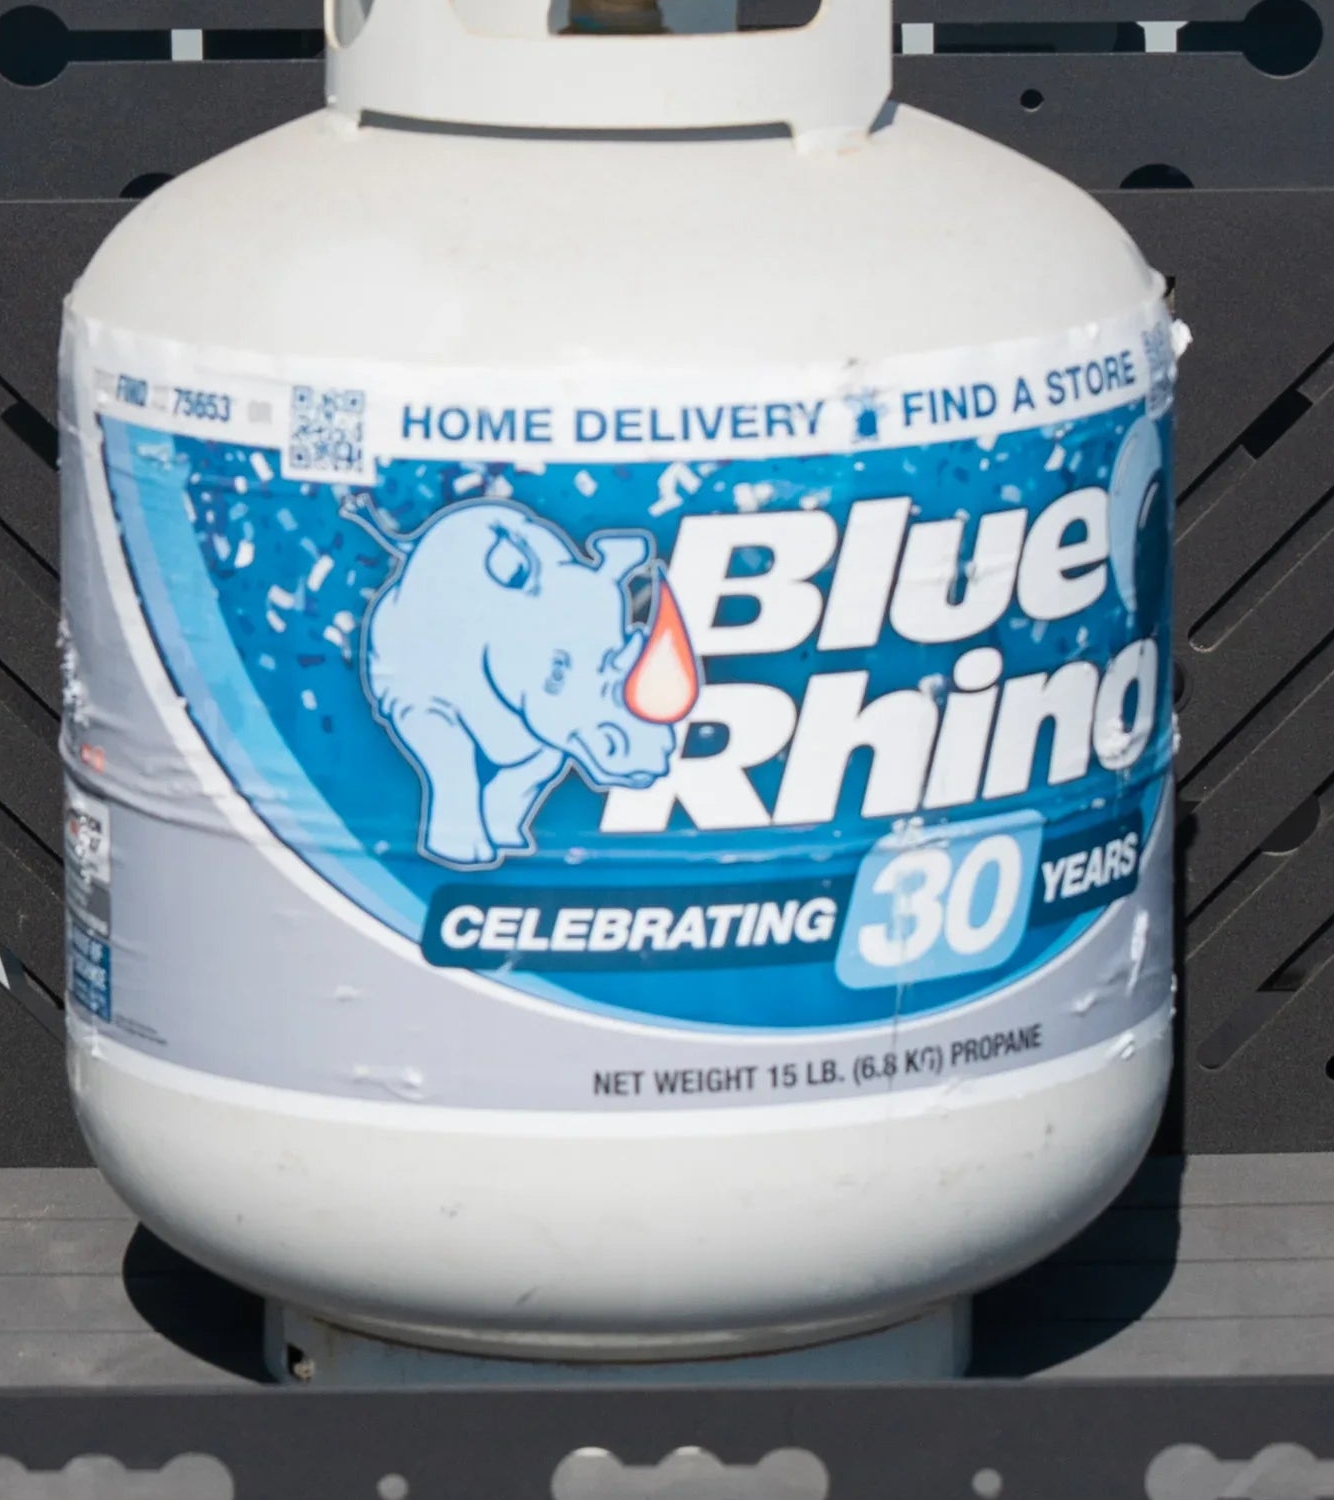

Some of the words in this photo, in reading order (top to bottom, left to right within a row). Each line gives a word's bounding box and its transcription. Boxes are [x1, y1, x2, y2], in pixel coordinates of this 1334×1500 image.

[401, 404, 553, 444] HOME
[573, 400, 825, 444] DELIVERY
[901, 381, 997, 428] FIND
[1012, 377, 1036, 413] A
[1046, 349, 1137, 408] STORE
[667, 485, 1112, 657] Blue
[599, 637, 1159, 834] Rhino
[439, 895, 838, 952] CELEBRATING
[857, 833, 1020, 967] 30
[1041, 831, 1138, 905] YEARS
[593, 1070, 643, 1097] NET
[654, 1065, 758, 1095] WEIGHT
[769, 1062, 798, 1089] 15
[807, 1058, 845, 1086] LB.
[852, 1054, 898, 1087] (6.8
[951, 1023, 1043, 1070] PROPANE
